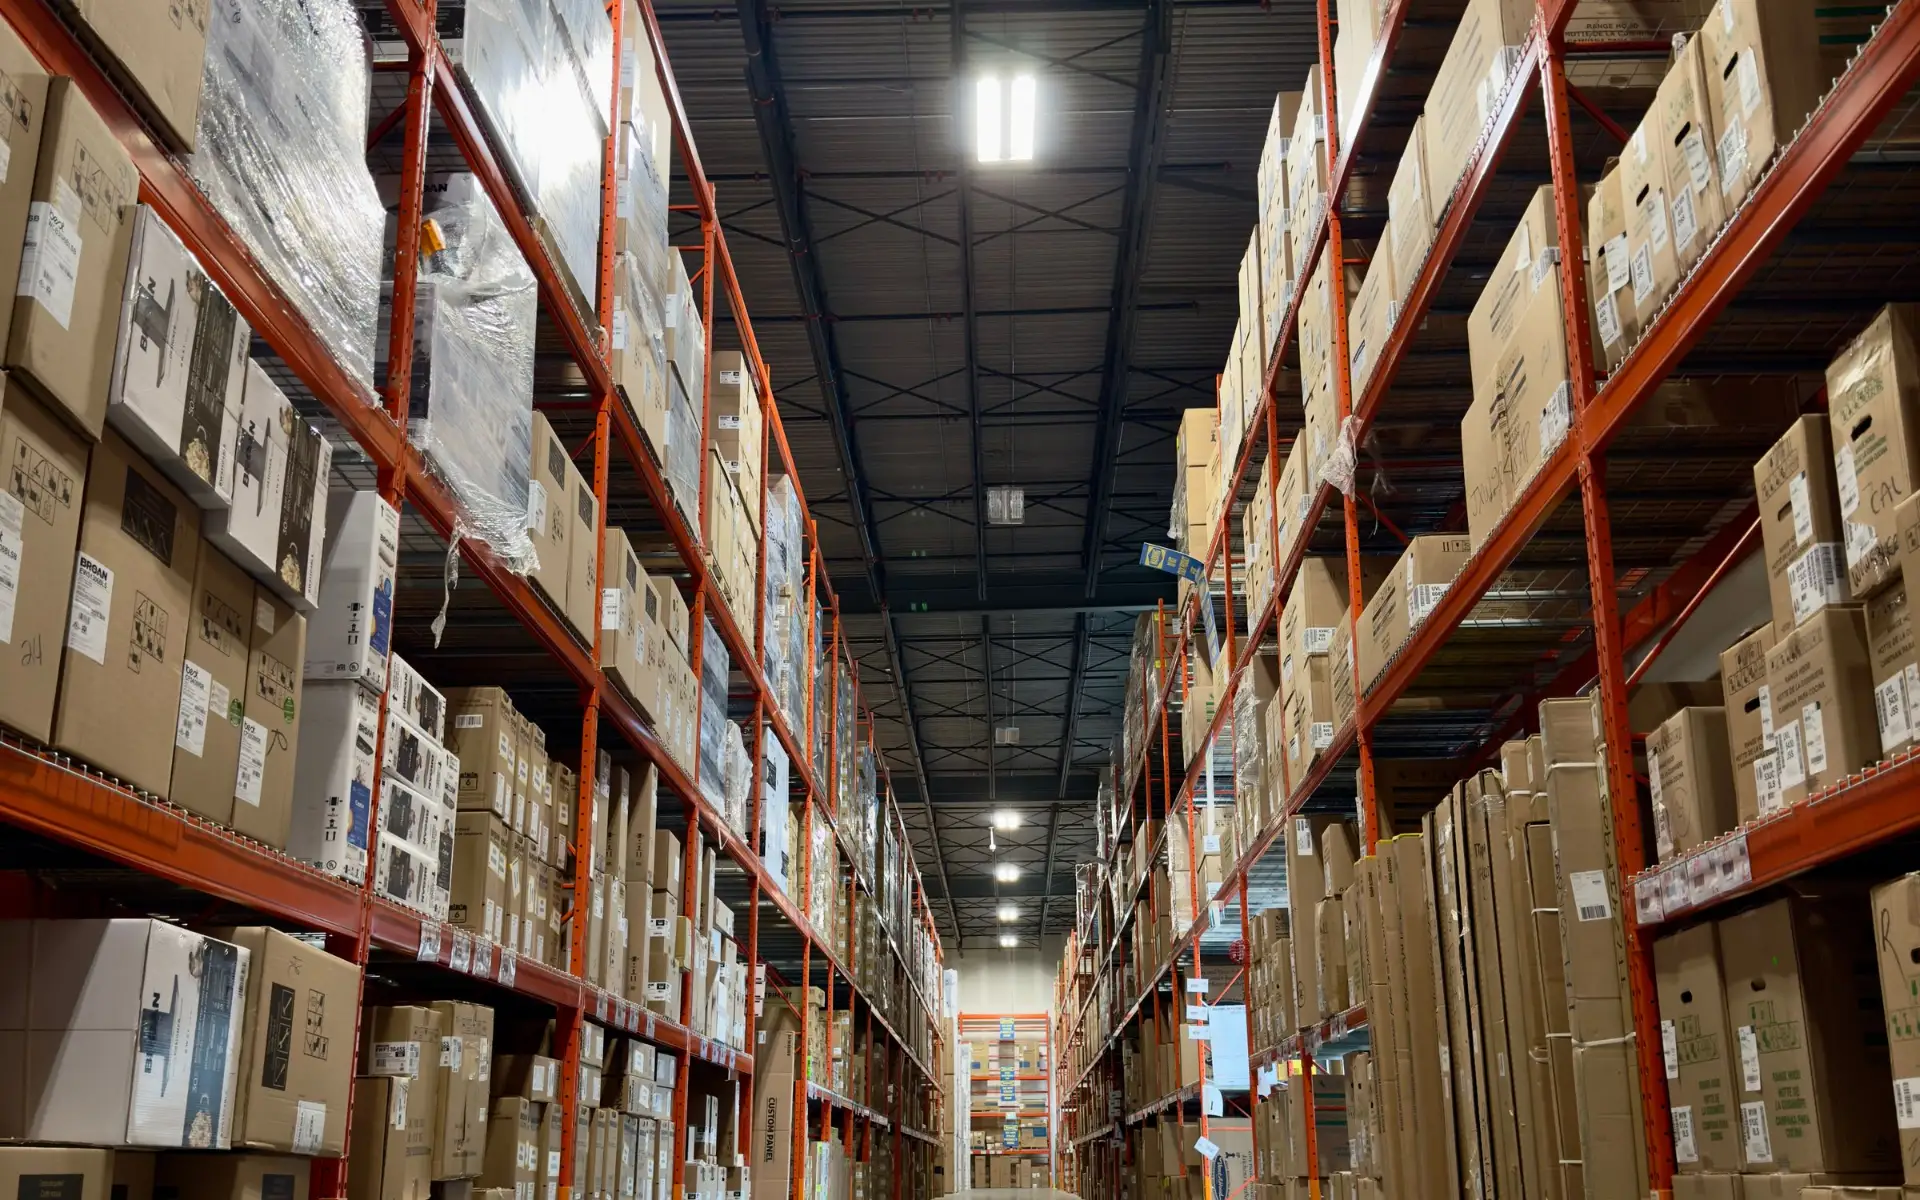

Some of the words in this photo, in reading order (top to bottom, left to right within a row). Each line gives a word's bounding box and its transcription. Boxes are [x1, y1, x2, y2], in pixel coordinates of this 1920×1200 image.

[80, 556, 108, 581] BROAN
[767, 1097, 776, 1133] CUSTOM
[766, 1134, 774, 1161] PANEL
